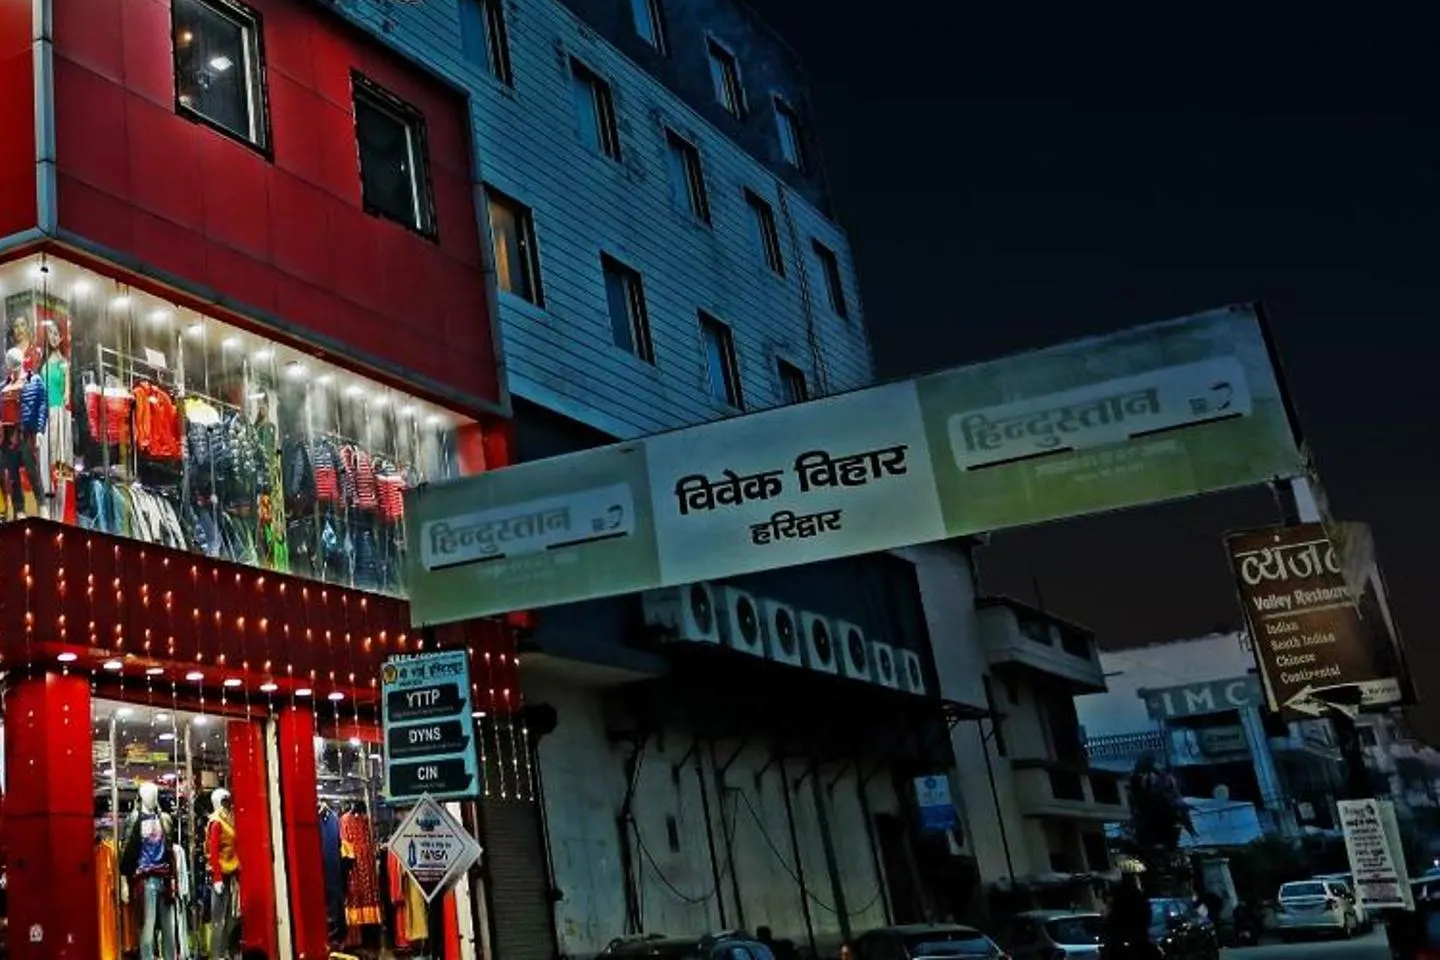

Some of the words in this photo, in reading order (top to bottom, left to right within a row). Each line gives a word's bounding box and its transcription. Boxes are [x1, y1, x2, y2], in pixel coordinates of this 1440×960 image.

[960, 387, 1161, 452] हिन्दुस्तान
[675, 469, 784, 515] विवेक
[793, 444, 908, 493] विहार
[429, 506, 572, 555] हिन्दुस्तान
[750, 509, 843, 545] हरिद्वार
[1253, 593, 1292, 611] Valley
[1265, 621, 1300, 635] Indian
[1301, 632, 1336, 645] Indian
[405, 689, 441, 708] YTTP
[1161, 680, 1250, 716] IMC
[408, 726, 441, 744] DYNS
[417, 765, 439, 781] CIN
